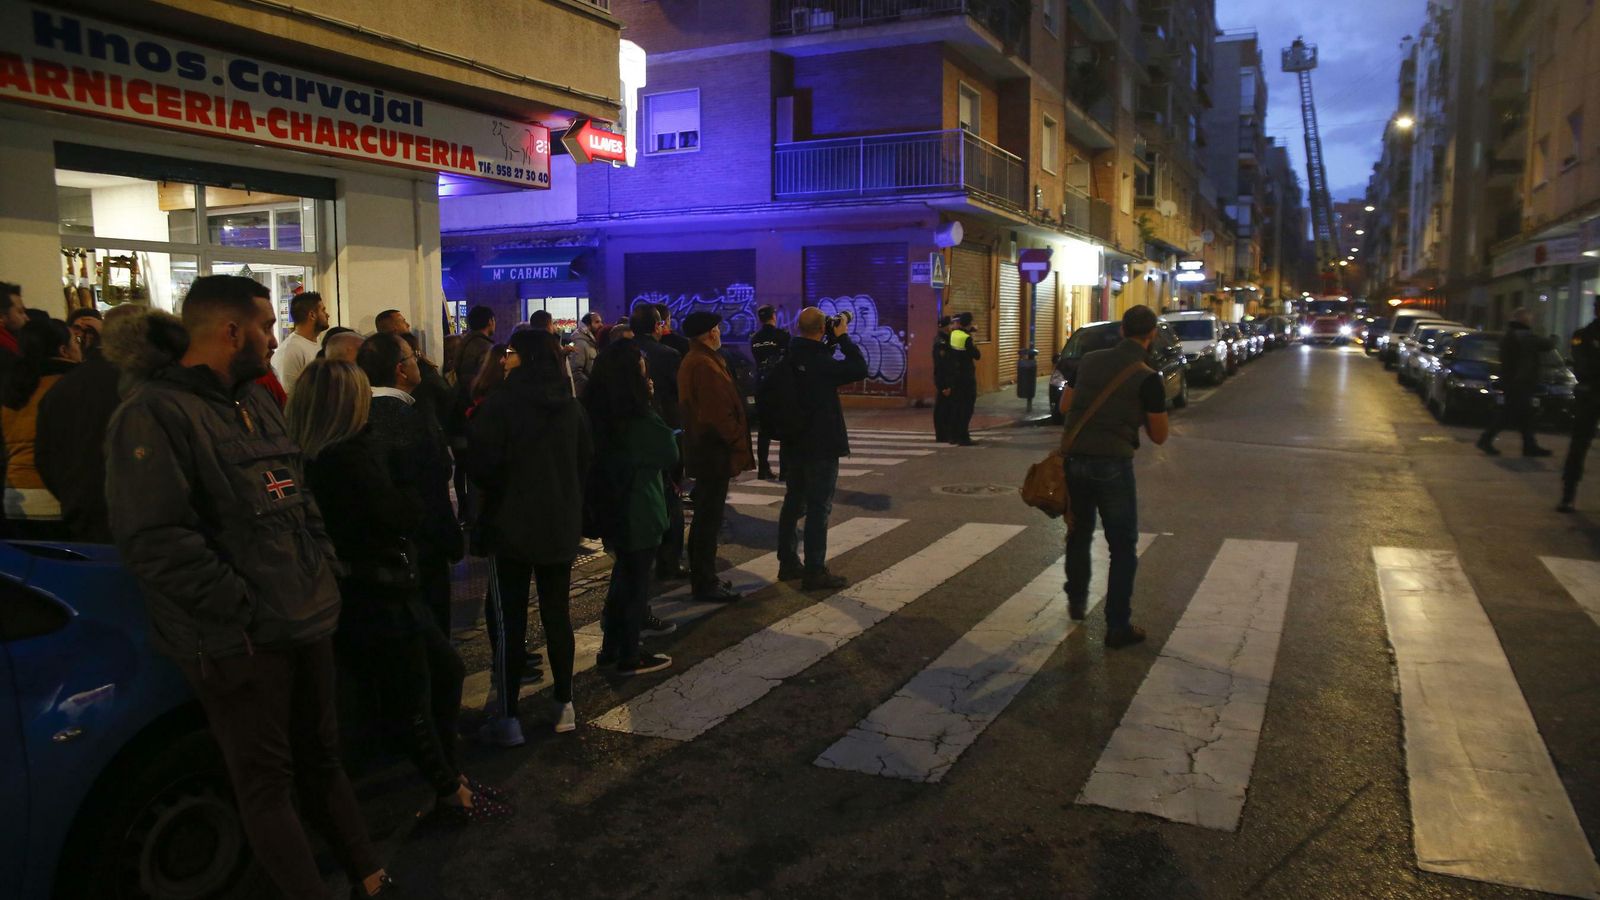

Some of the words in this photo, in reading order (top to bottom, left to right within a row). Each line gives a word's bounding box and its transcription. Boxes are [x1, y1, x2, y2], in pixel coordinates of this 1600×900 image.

[590, 135, 623, 154] LLAVES
[496, 164, 512, 177] 958
[514, 168, 524, 179] 27
[526, 170, 536, 181] 30
[538, 172, 548, 184] 40
[510, 267, 558, 280] CARMEN
